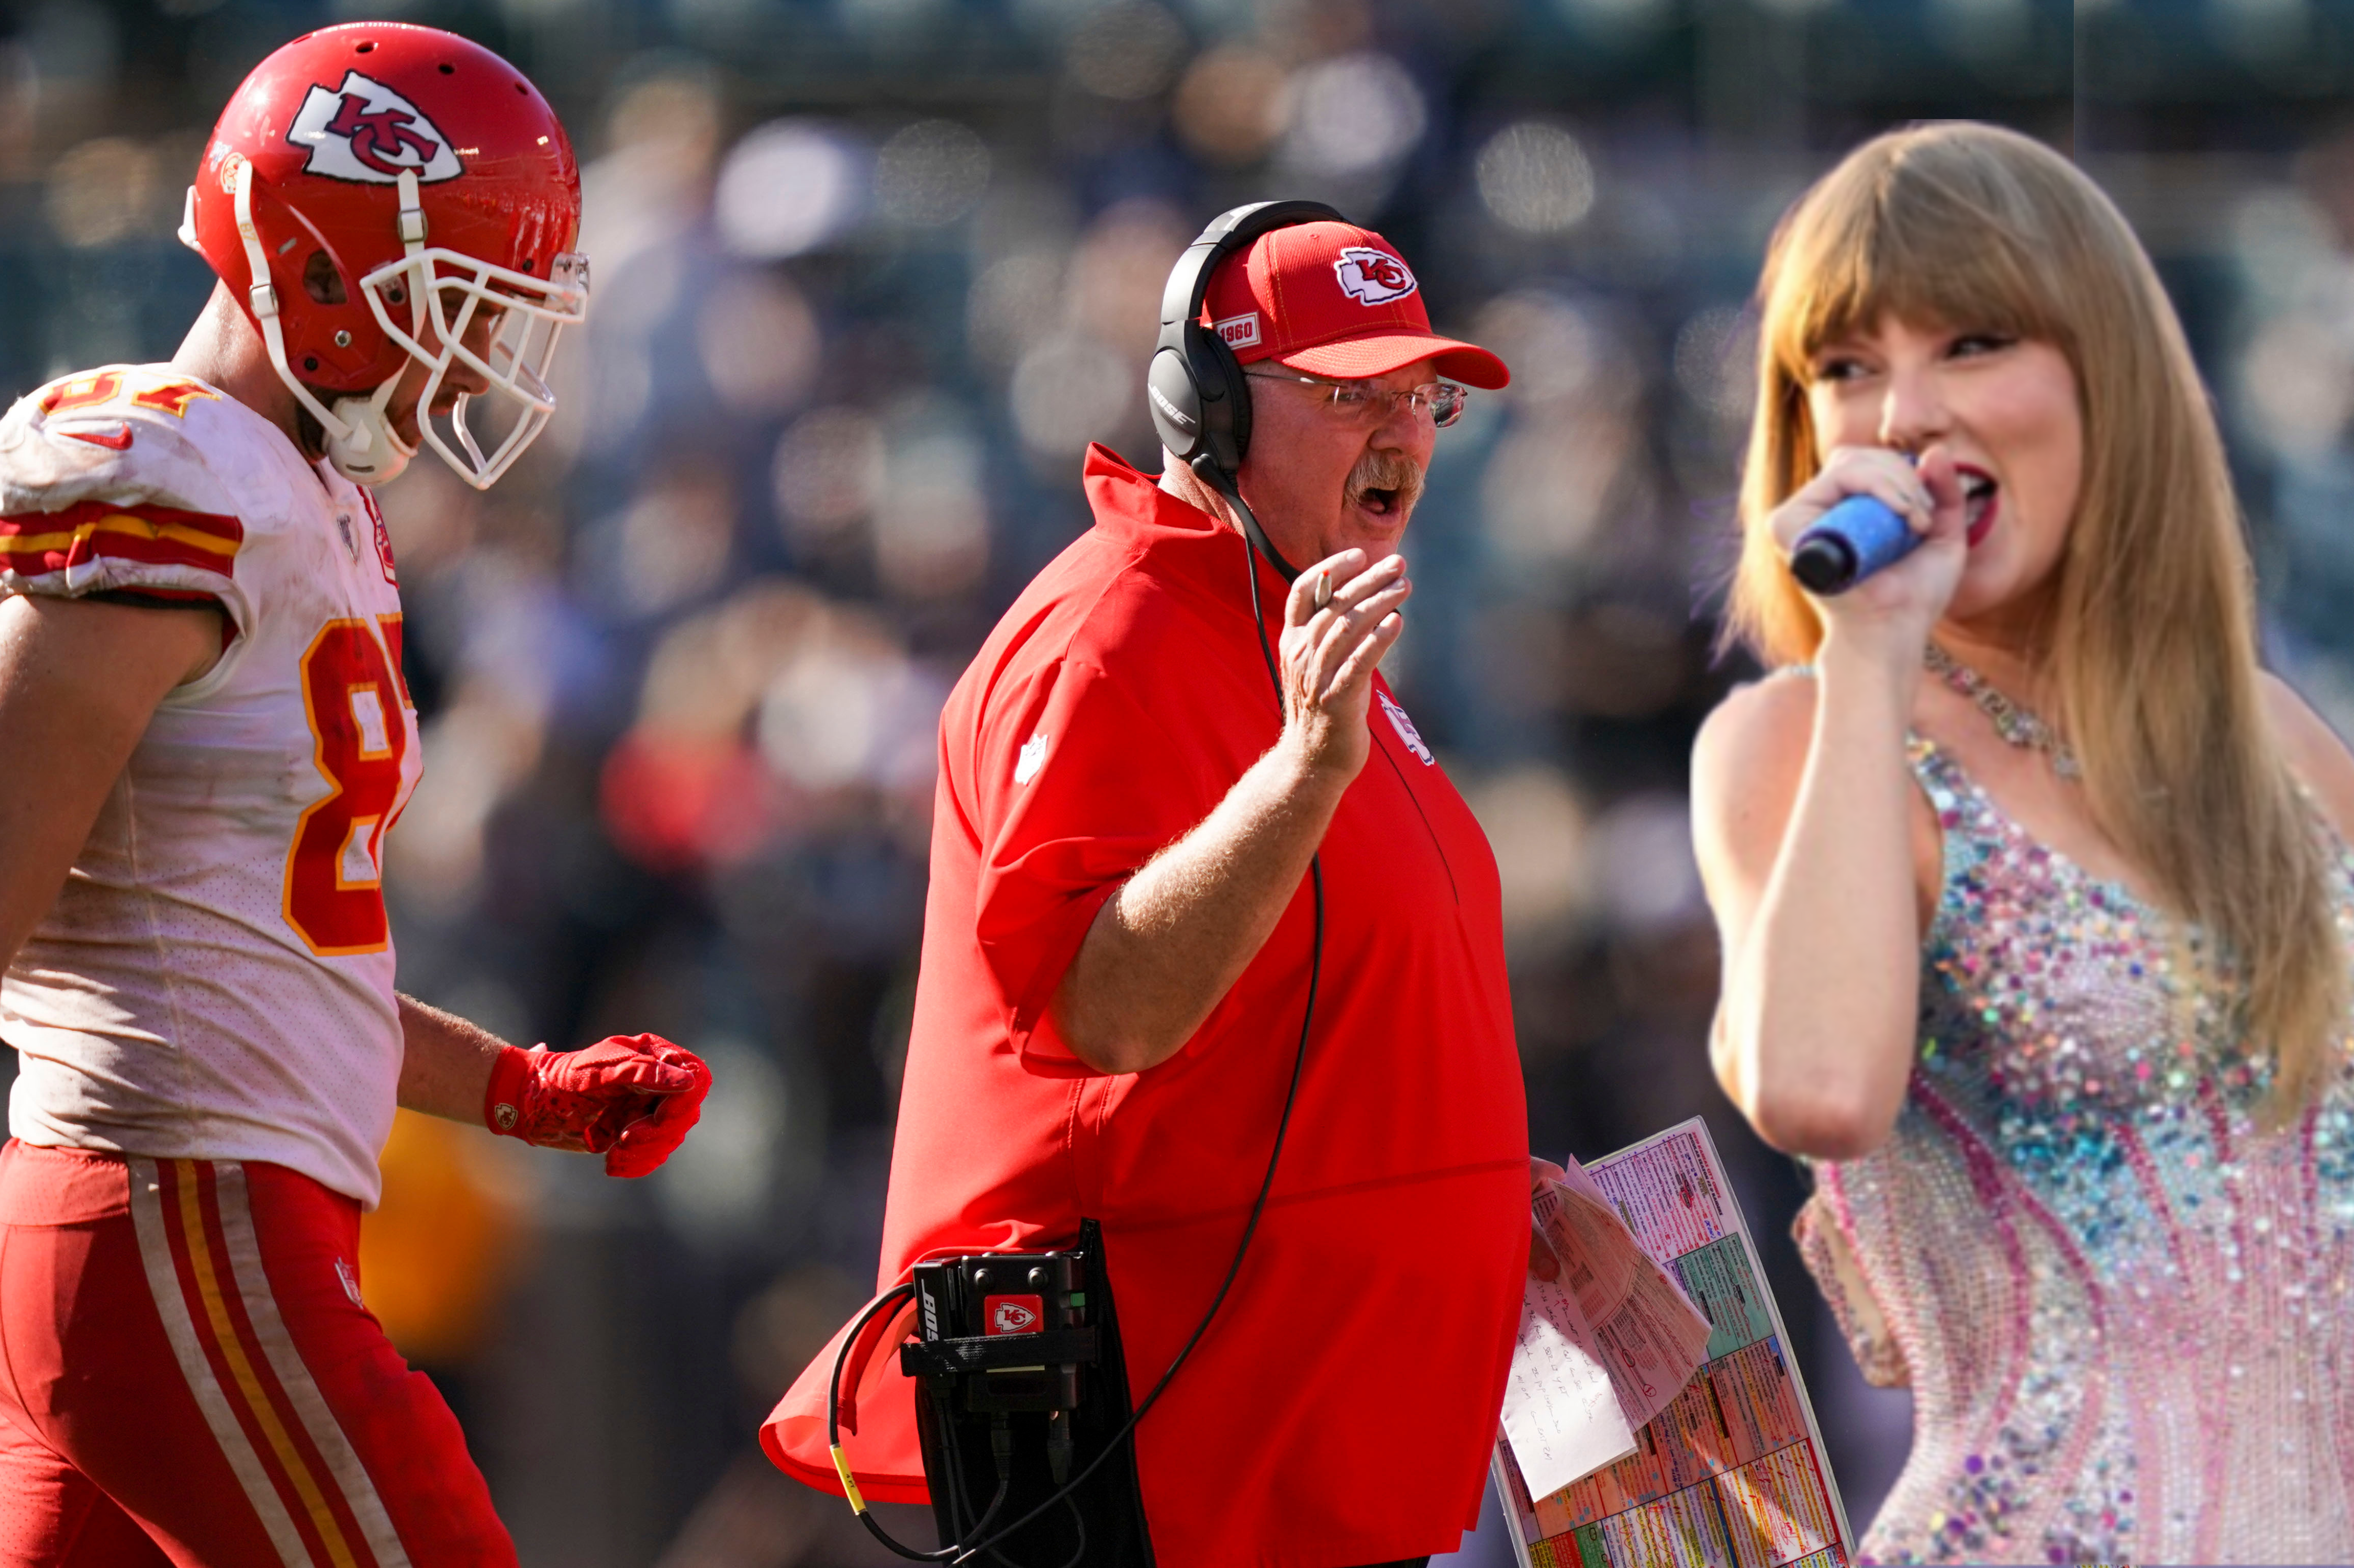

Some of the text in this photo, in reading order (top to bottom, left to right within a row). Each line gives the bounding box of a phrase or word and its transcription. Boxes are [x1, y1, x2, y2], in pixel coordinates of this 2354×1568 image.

[325, 93, 439, 176] KC
[239, 222, 258, 242] 87
[1355, 258, 1408, 291] KC
[1220, 322, 1253, 342] 1960
[1147, 382, 1196, 425] BOSE
[1697, 1144, 1709, 1168] KANSAS
[1706, 1167, 1714, 1181] CITY
[1711, 1180, 1722, 1199] CHIEFS
[1698, 1158, 1709, 1180] SEASON
[1711, 1192, 1723, 1216] RAIDERS
[921, 1279, 939, 1342] BOS
[1004, 1308, 1027, 1325] KC
